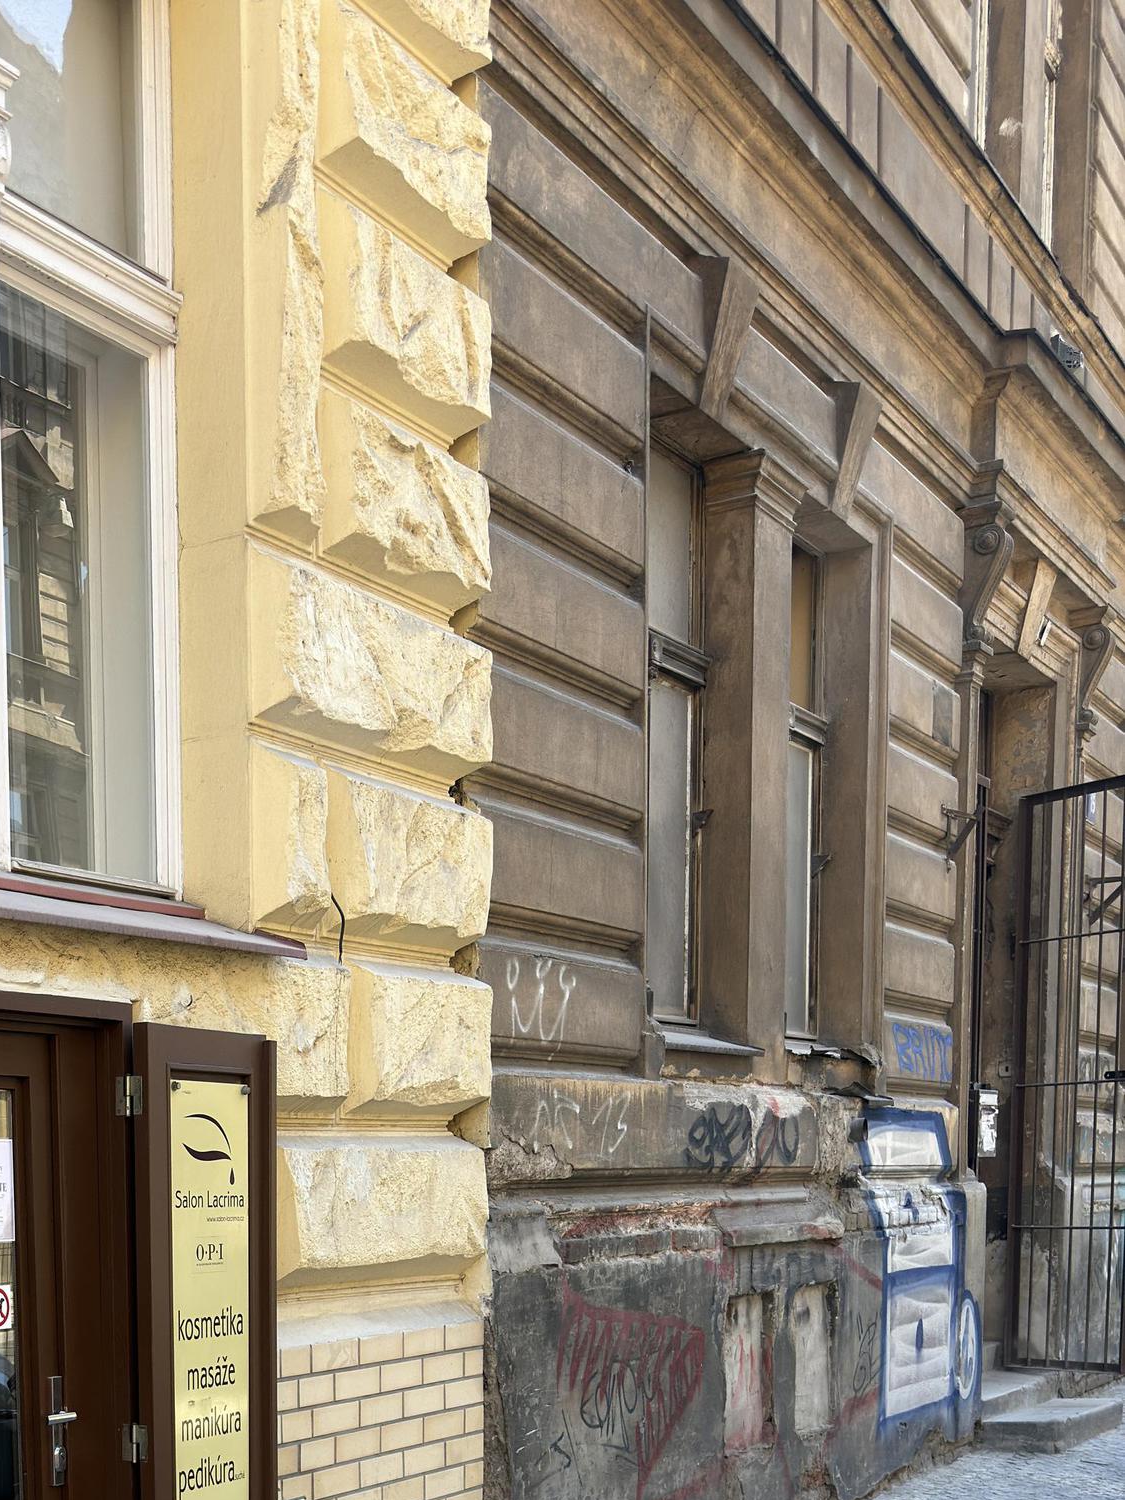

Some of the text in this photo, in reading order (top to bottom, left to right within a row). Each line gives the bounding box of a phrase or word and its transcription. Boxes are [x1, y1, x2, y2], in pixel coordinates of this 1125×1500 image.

[175, 1190, 245, 1209] Salon Lacrima
[177, 1305, 244, 1342] kosmetika
[187, 1355, 236, 1391] masáže
[181, 1404, 241, 1442] manikúra
